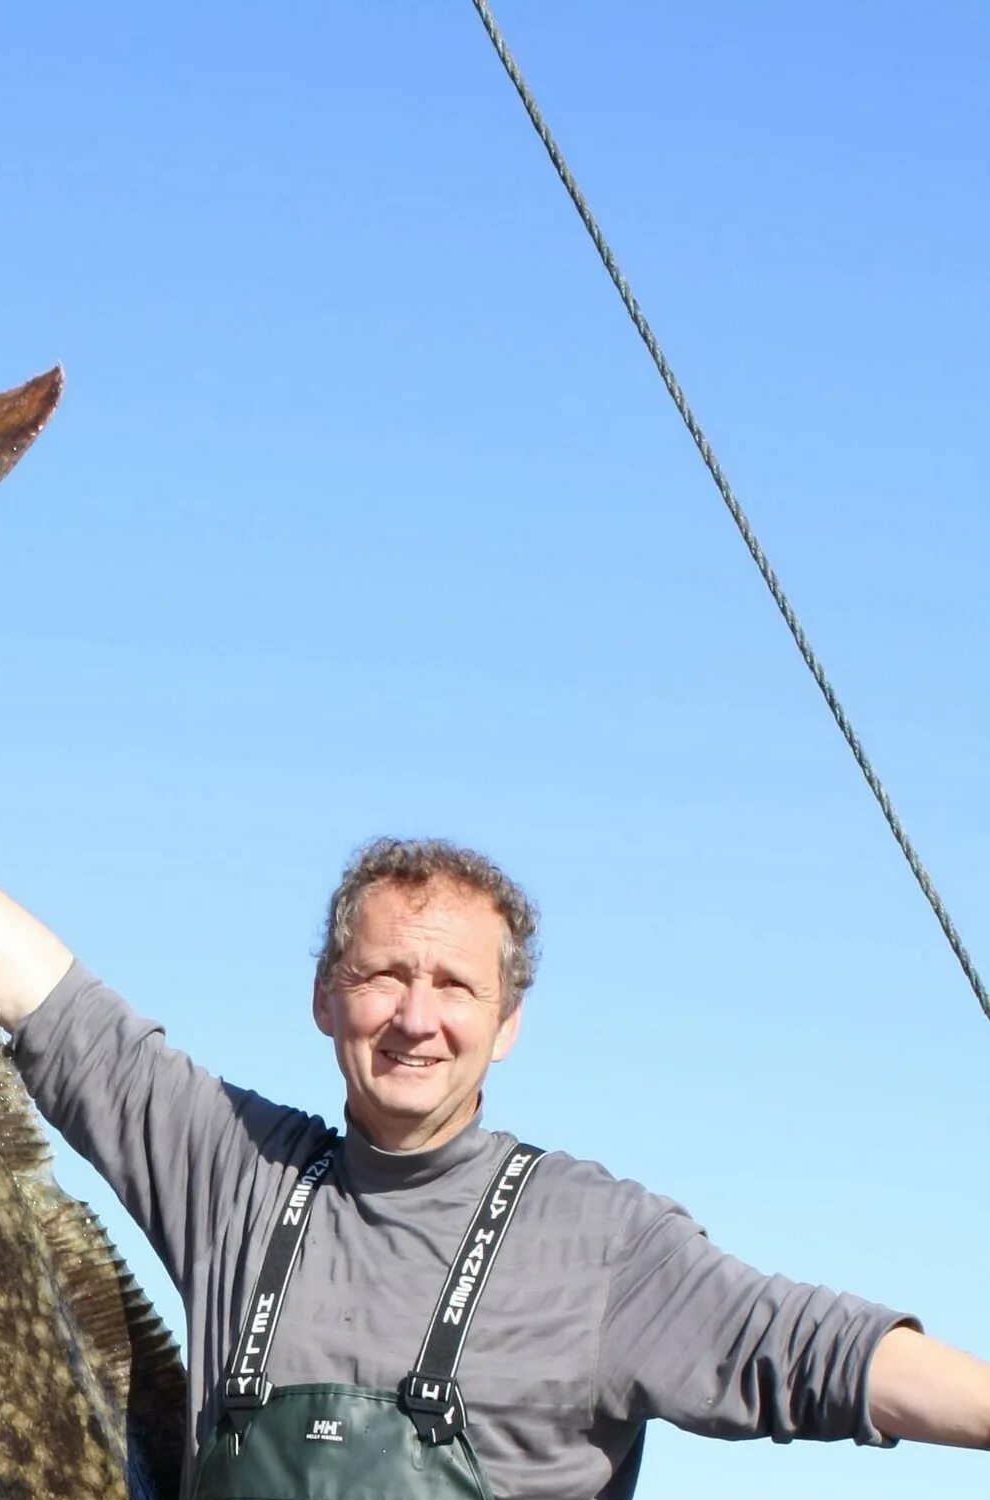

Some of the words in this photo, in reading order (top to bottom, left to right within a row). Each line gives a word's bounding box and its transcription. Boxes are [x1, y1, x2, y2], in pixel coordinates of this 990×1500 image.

[489, 1153, 532, 1219] HELLY
[443, 1229, 495, 1325] HANSEN
[237, 1293, 275, 1394] HELLY
[313, 1420, 337, 1435] HH
